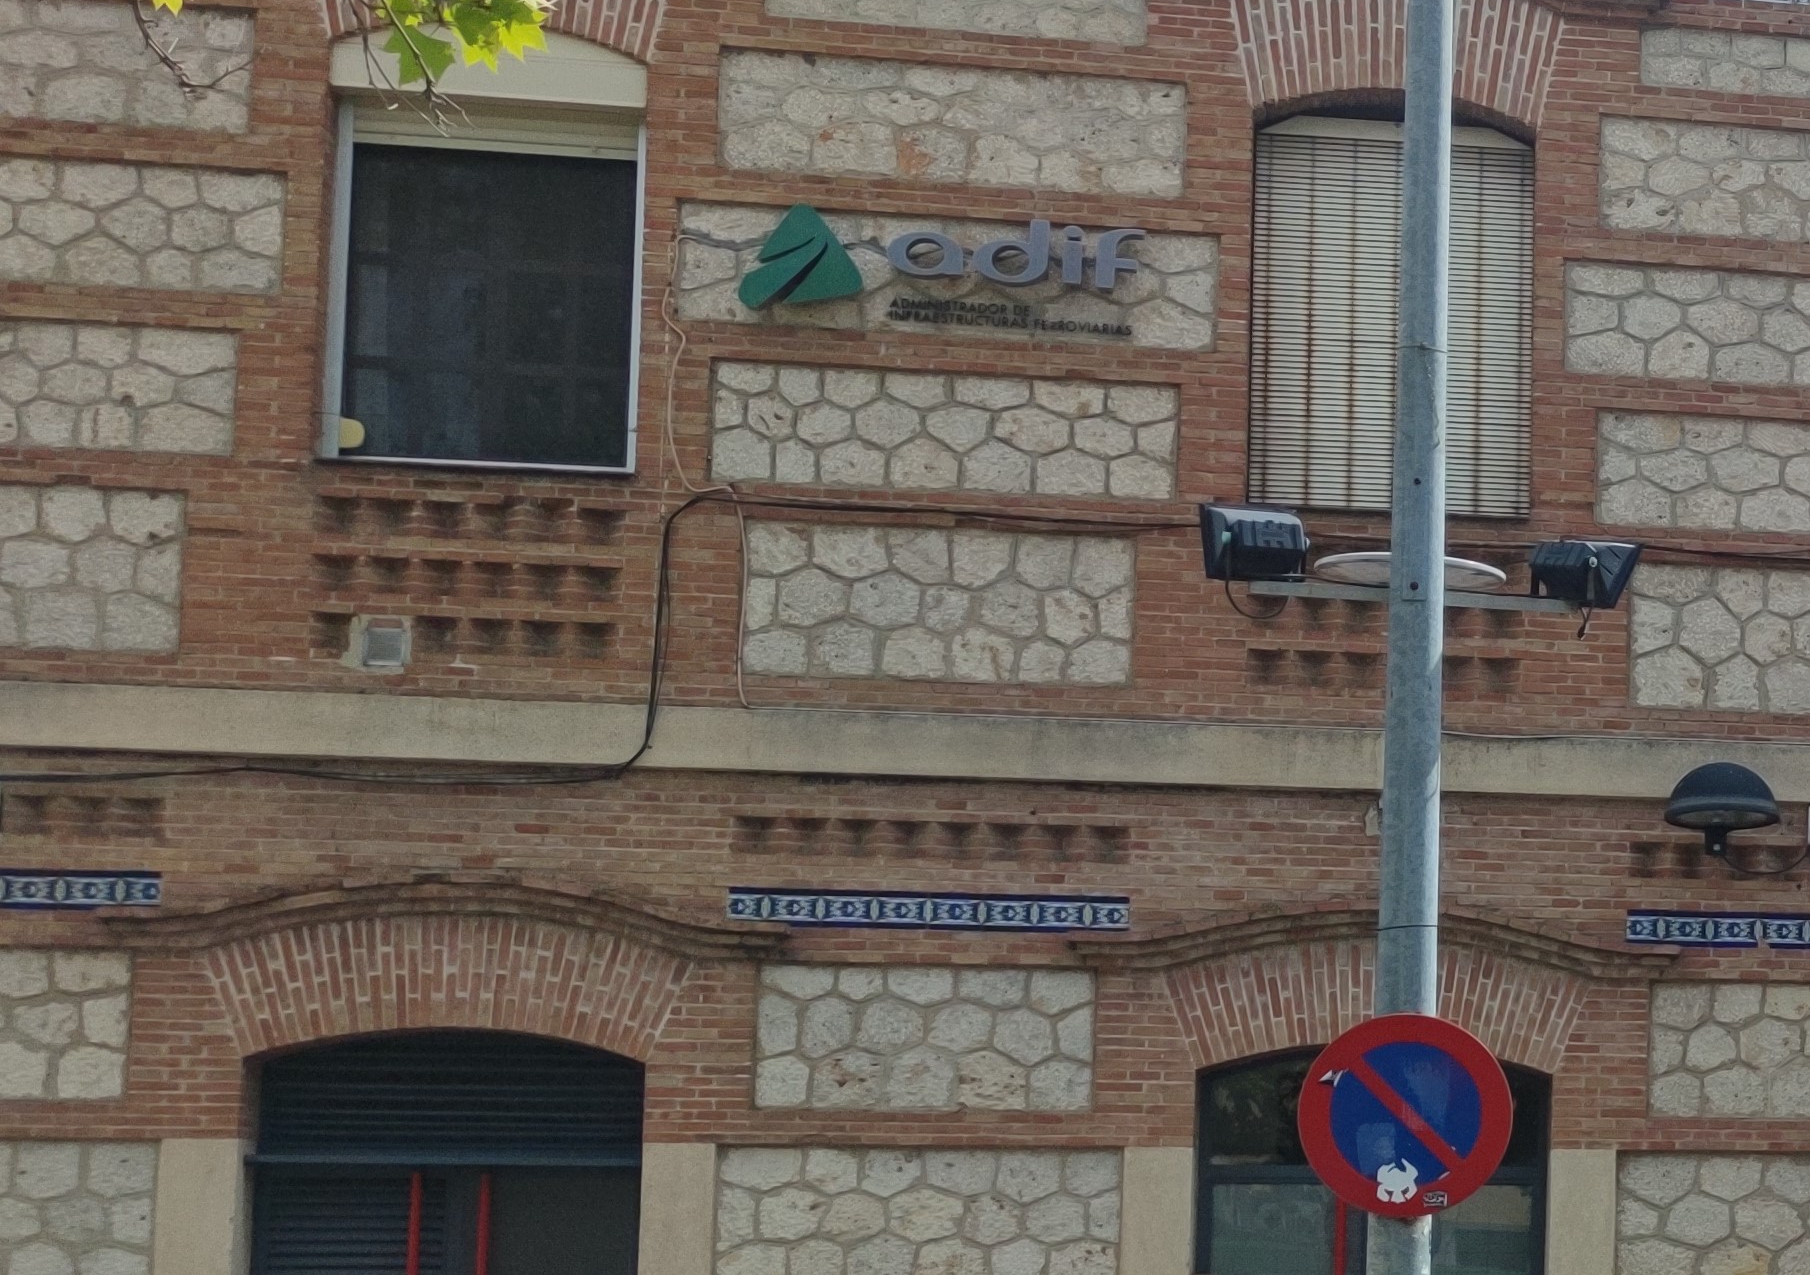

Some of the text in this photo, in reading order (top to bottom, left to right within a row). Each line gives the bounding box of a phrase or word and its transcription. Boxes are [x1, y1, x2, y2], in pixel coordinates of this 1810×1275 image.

[887, 219, 1146, 290] adif
[889, 296, 1031, 317] ADMINISTRADOR DE
[888, 310, 1028, 328] INFRAESTRUCTURAS
